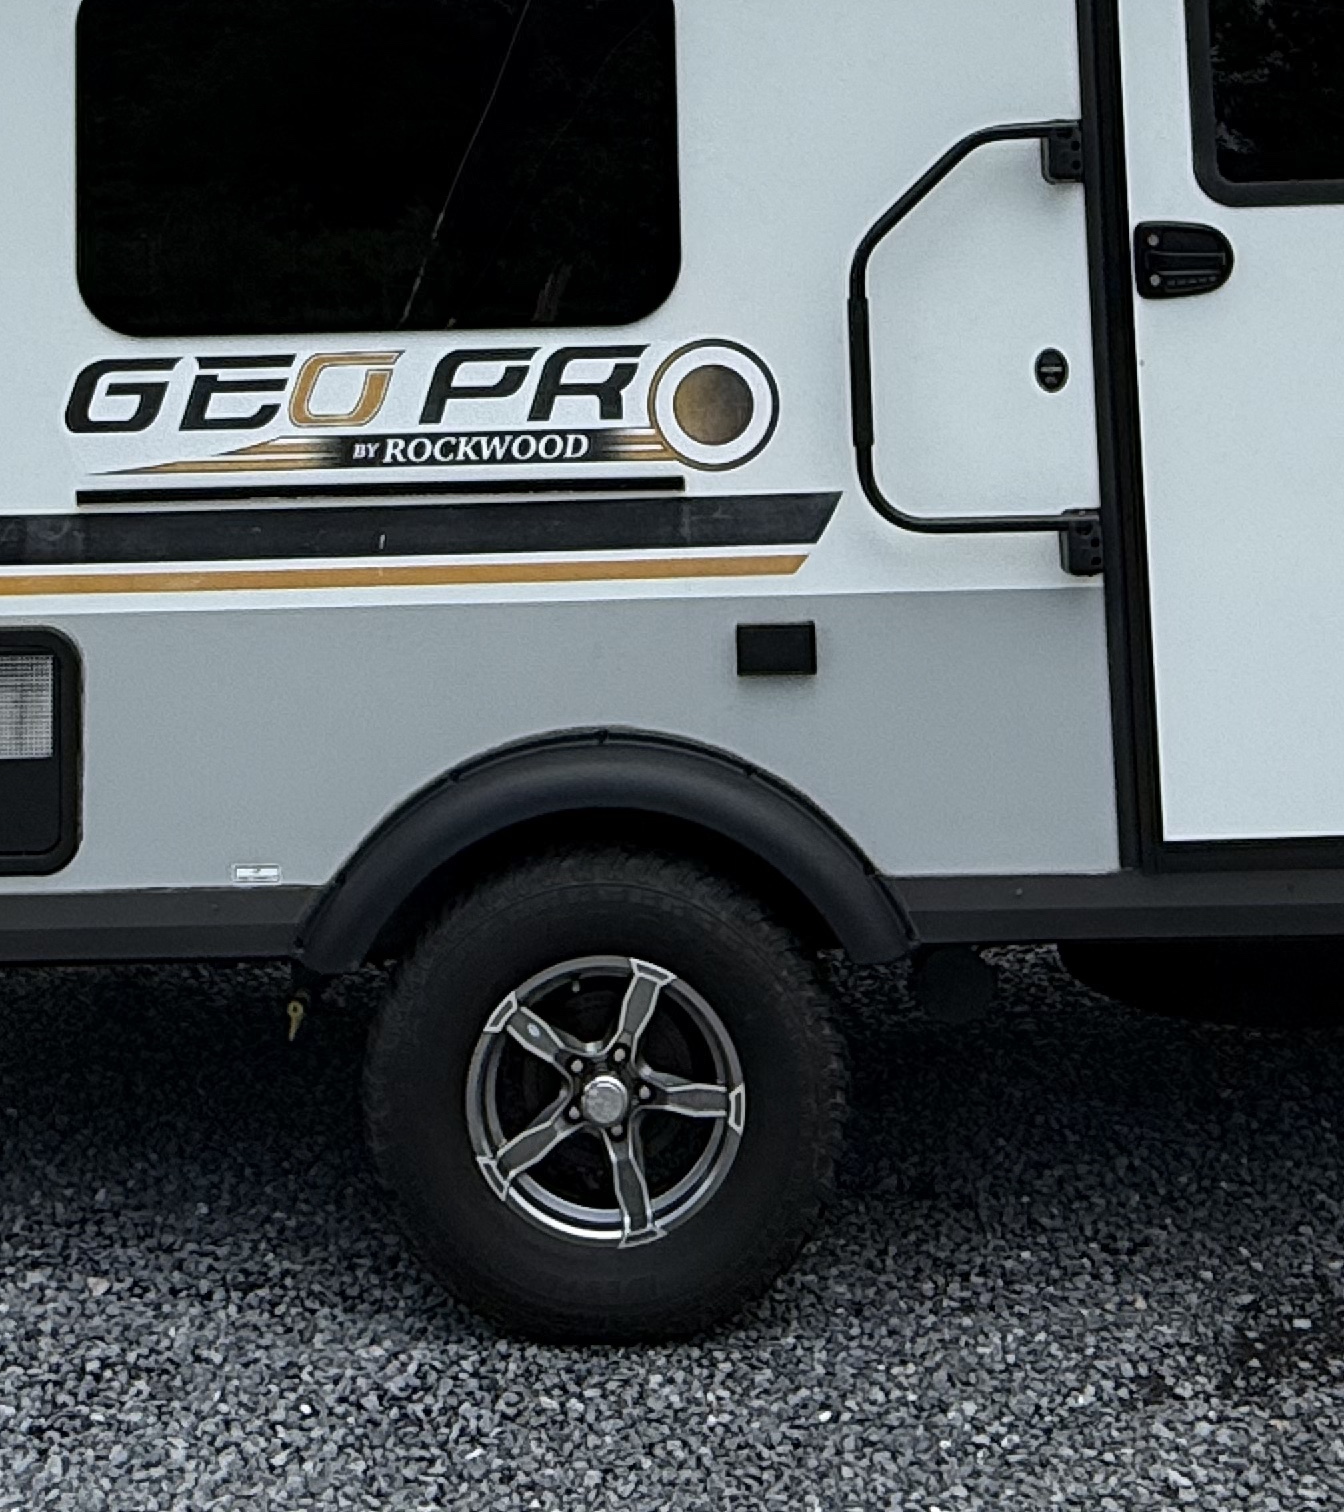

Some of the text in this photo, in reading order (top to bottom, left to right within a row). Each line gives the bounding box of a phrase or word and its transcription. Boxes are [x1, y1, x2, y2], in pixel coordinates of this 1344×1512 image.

[65, 350, 405, 434] GEO
[352, 434, 591, 464] BY ROCKWOOD
